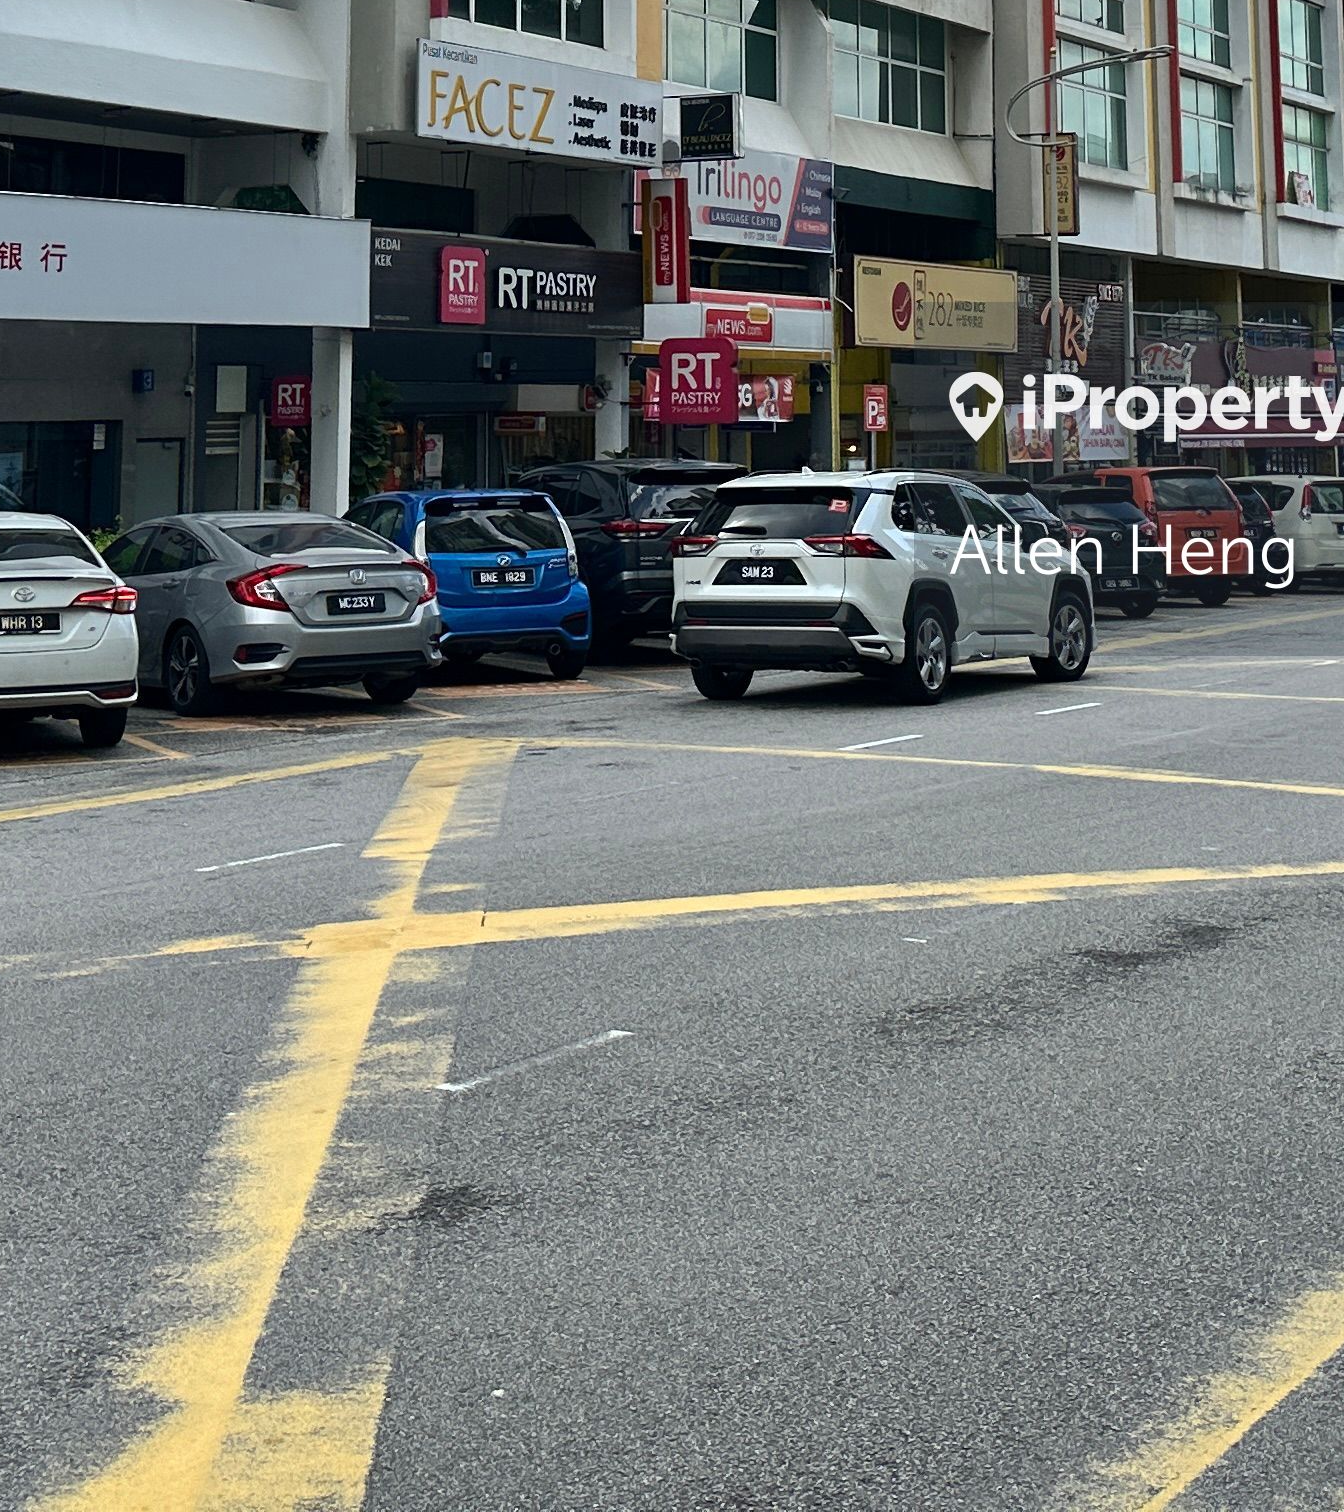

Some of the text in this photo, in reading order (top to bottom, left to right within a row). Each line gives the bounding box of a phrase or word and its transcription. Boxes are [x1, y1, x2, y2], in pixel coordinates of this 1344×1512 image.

[427, 69, 556, 145] FACEZ
[572, 113, 596, 129] Laser
[711, 211, 750, 226] LANGUAGE
[751, 215, 779, 229] CENTRE
[374, 237, 401, 251] KEDAI
[374, 254, 393, 267] KEK
[448, 259, 479, 293] RT
[498, 266, 534, 310] RT
[535, 271, 597, 298] PASTRY
[448, 294, 479, 307] PASTRY
[927, 291, 955, 327] 282
[671, 352, 721, 390] RT
[277, 382, 305, 407] RT
[671, 391, 721, 405] PASTRY
[868, 400, 879, 425] P
[741, 566, 774, 578] SAM 23
[0, 616, 44, 630] WHR 13
